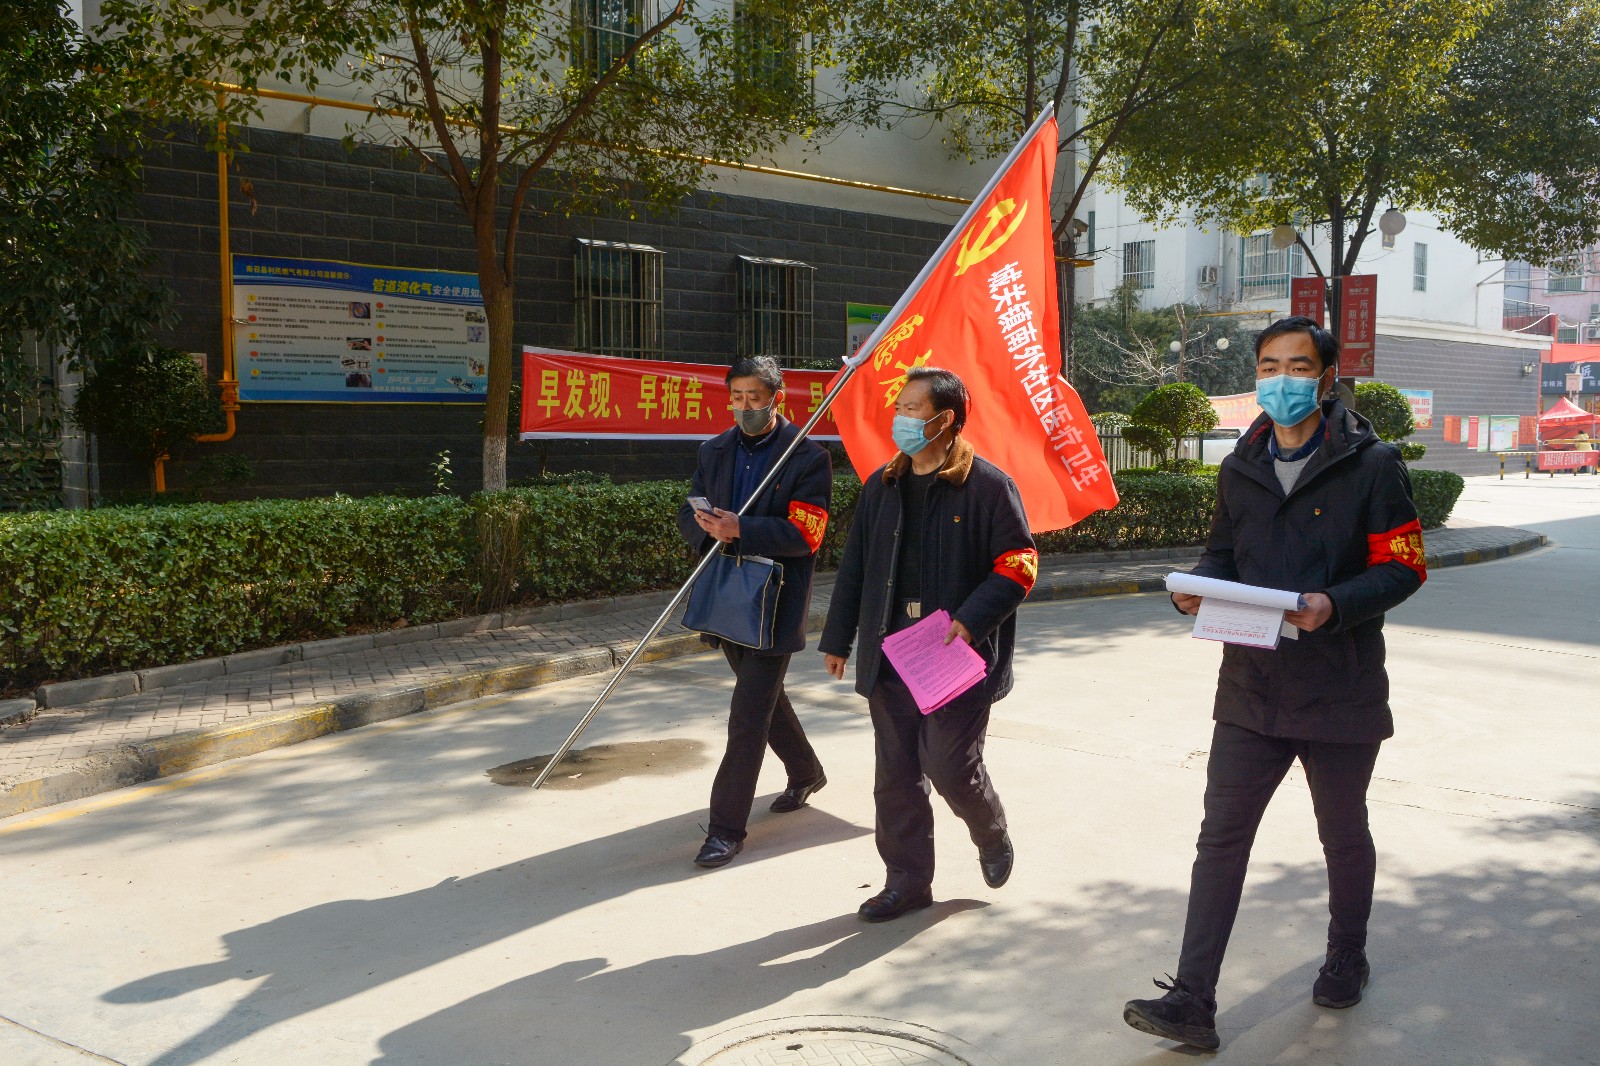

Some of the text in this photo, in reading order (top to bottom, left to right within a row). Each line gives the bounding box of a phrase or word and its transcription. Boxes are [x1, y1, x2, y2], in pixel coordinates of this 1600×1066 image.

[1347, 303, 1357, 340] 一期房源
[1359, 299, 1369, 340] 所剩不多
[987, 261, 1101, 492] 城关镇南外社区医疗卫生
